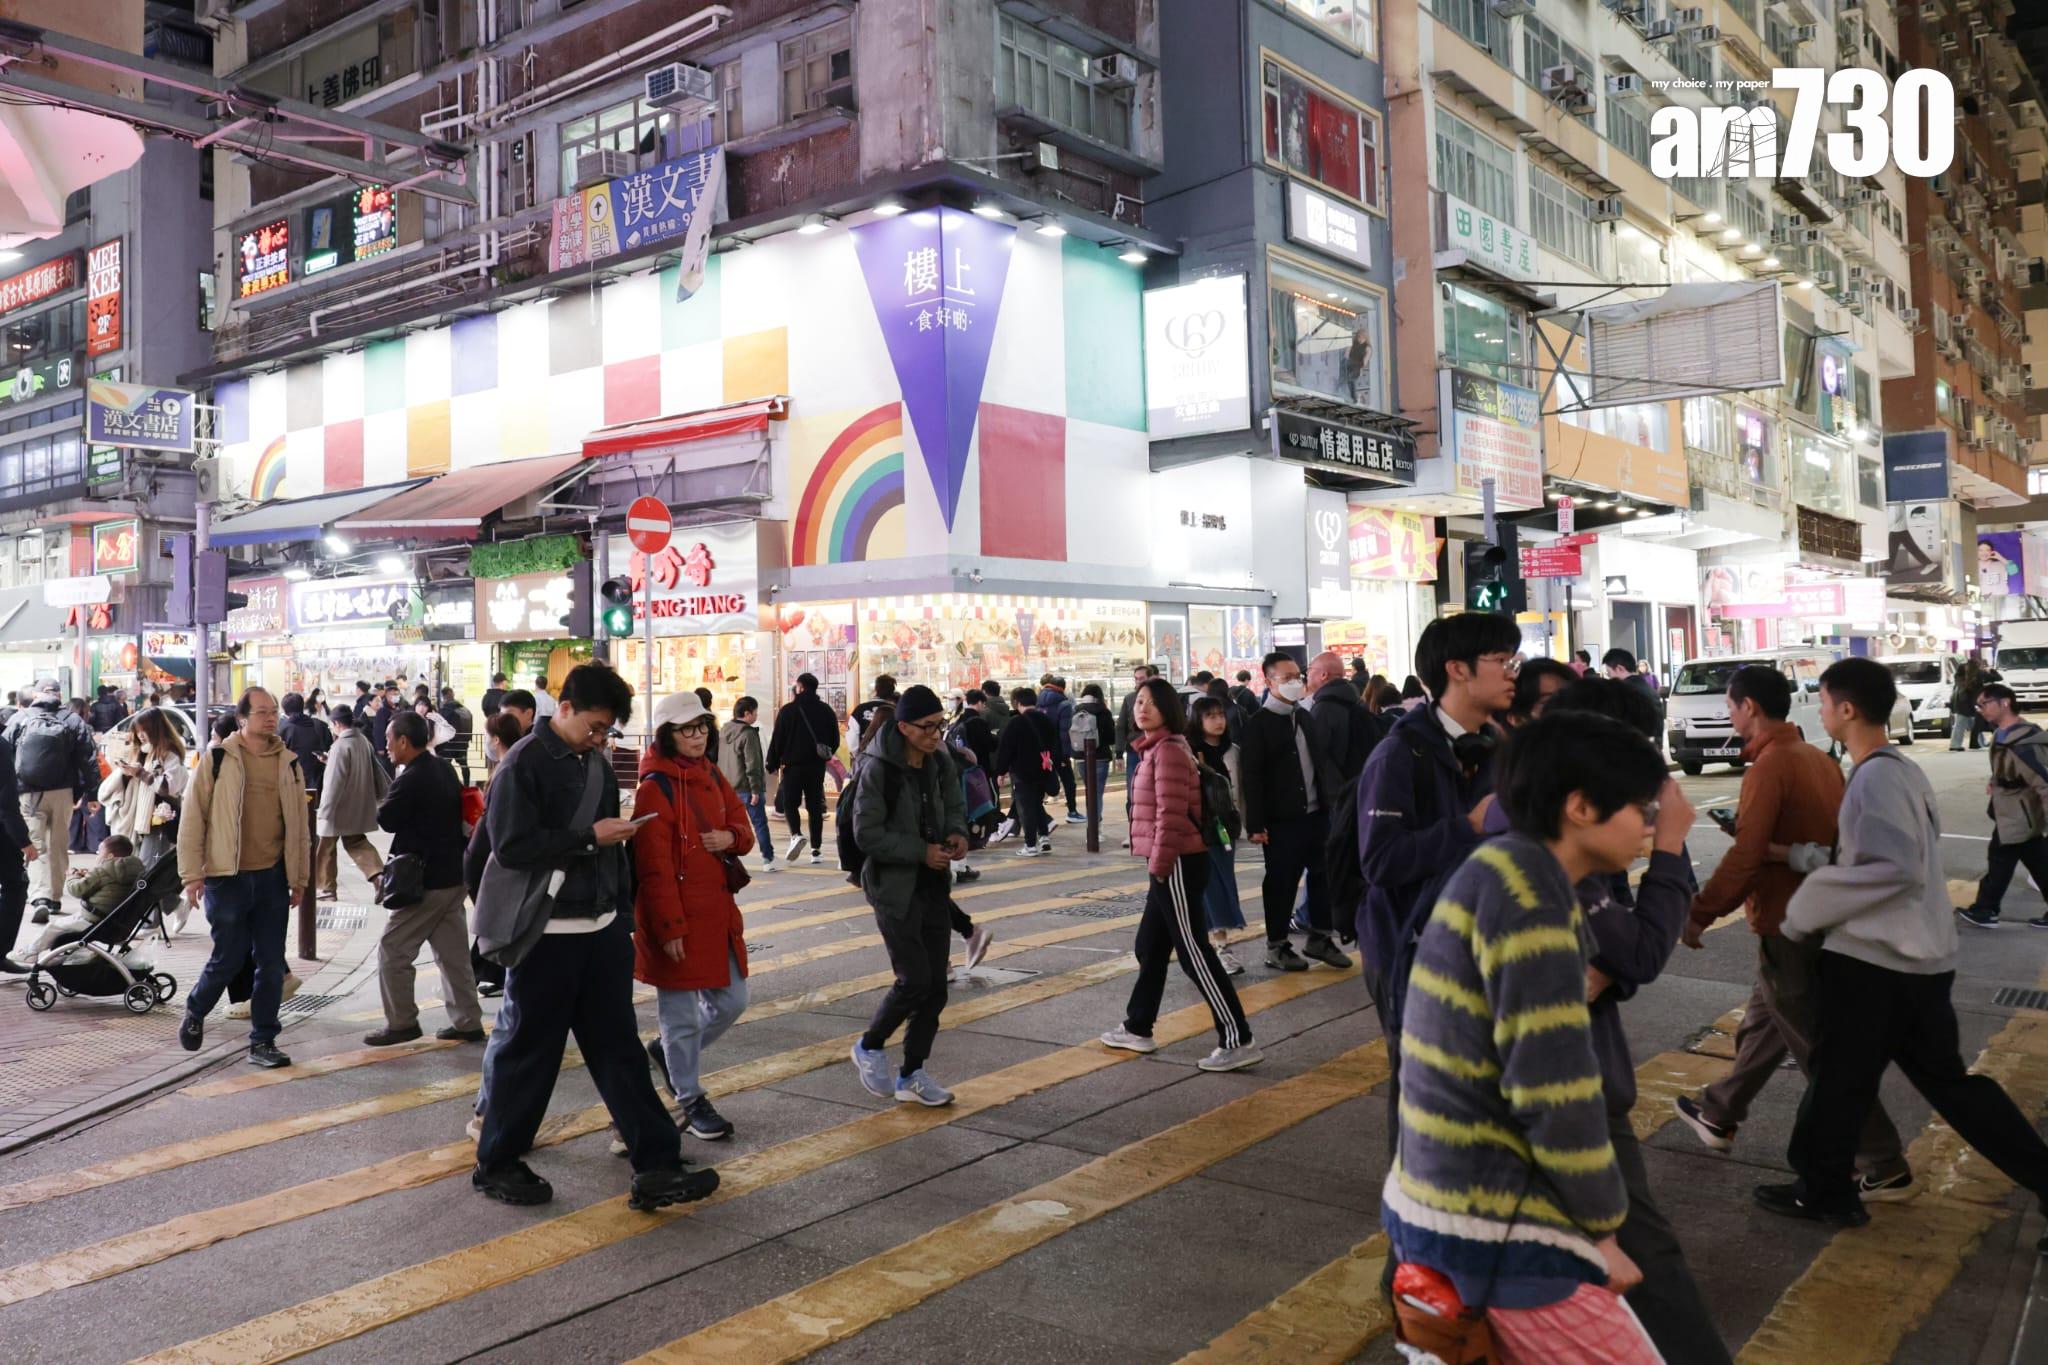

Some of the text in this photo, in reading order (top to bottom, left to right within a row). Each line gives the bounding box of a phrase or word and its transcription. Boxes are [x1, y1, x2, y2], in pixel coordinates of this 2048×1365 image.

[308, 55, 380, 108] 上善佛印
[88, 242, 120, 274] MEH
[1456, 208, 1531, 273] 田園書屋
[0, 260, 74, 312] 蒙古大草原頂級羊肉
[88, 266, 120, 300] KEE
[903, 247, 975, 297] 樓上
[97, 314, 111, 335] 2F
[103, 409, 179, 433] 漢文書店
[1320, 426, 1394, 472] 情趣用品店
[688, 594, 745, 616] HIANG
